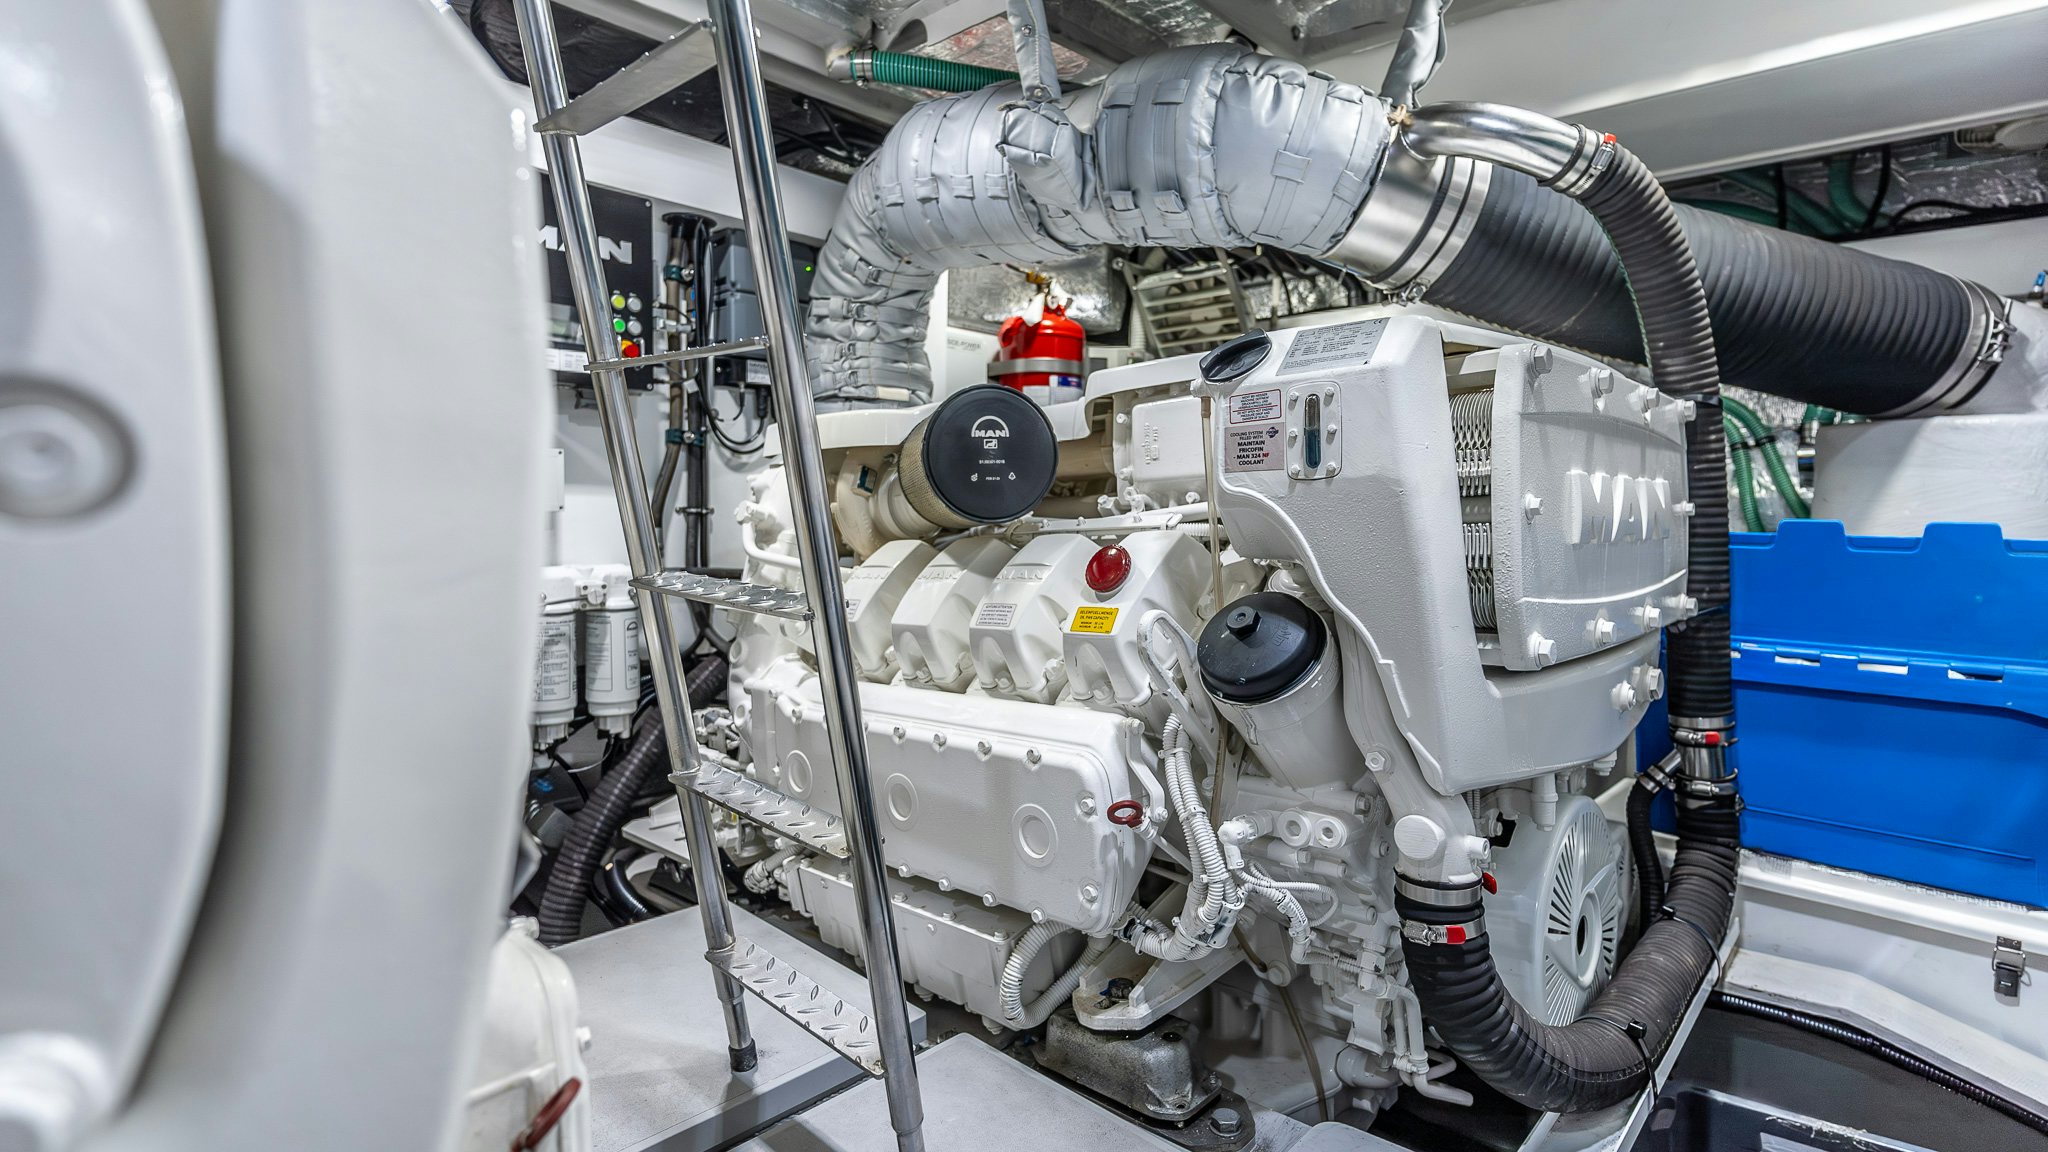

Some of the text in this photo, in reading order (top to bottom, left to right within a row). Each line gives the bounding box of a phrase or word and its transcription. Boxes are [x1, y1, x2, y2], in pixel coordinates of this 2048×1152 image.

[537, 225, 632, 265] MN
[974, 429, 1006, 437] MAN
[1564, 468, 1673, 545] MAN
